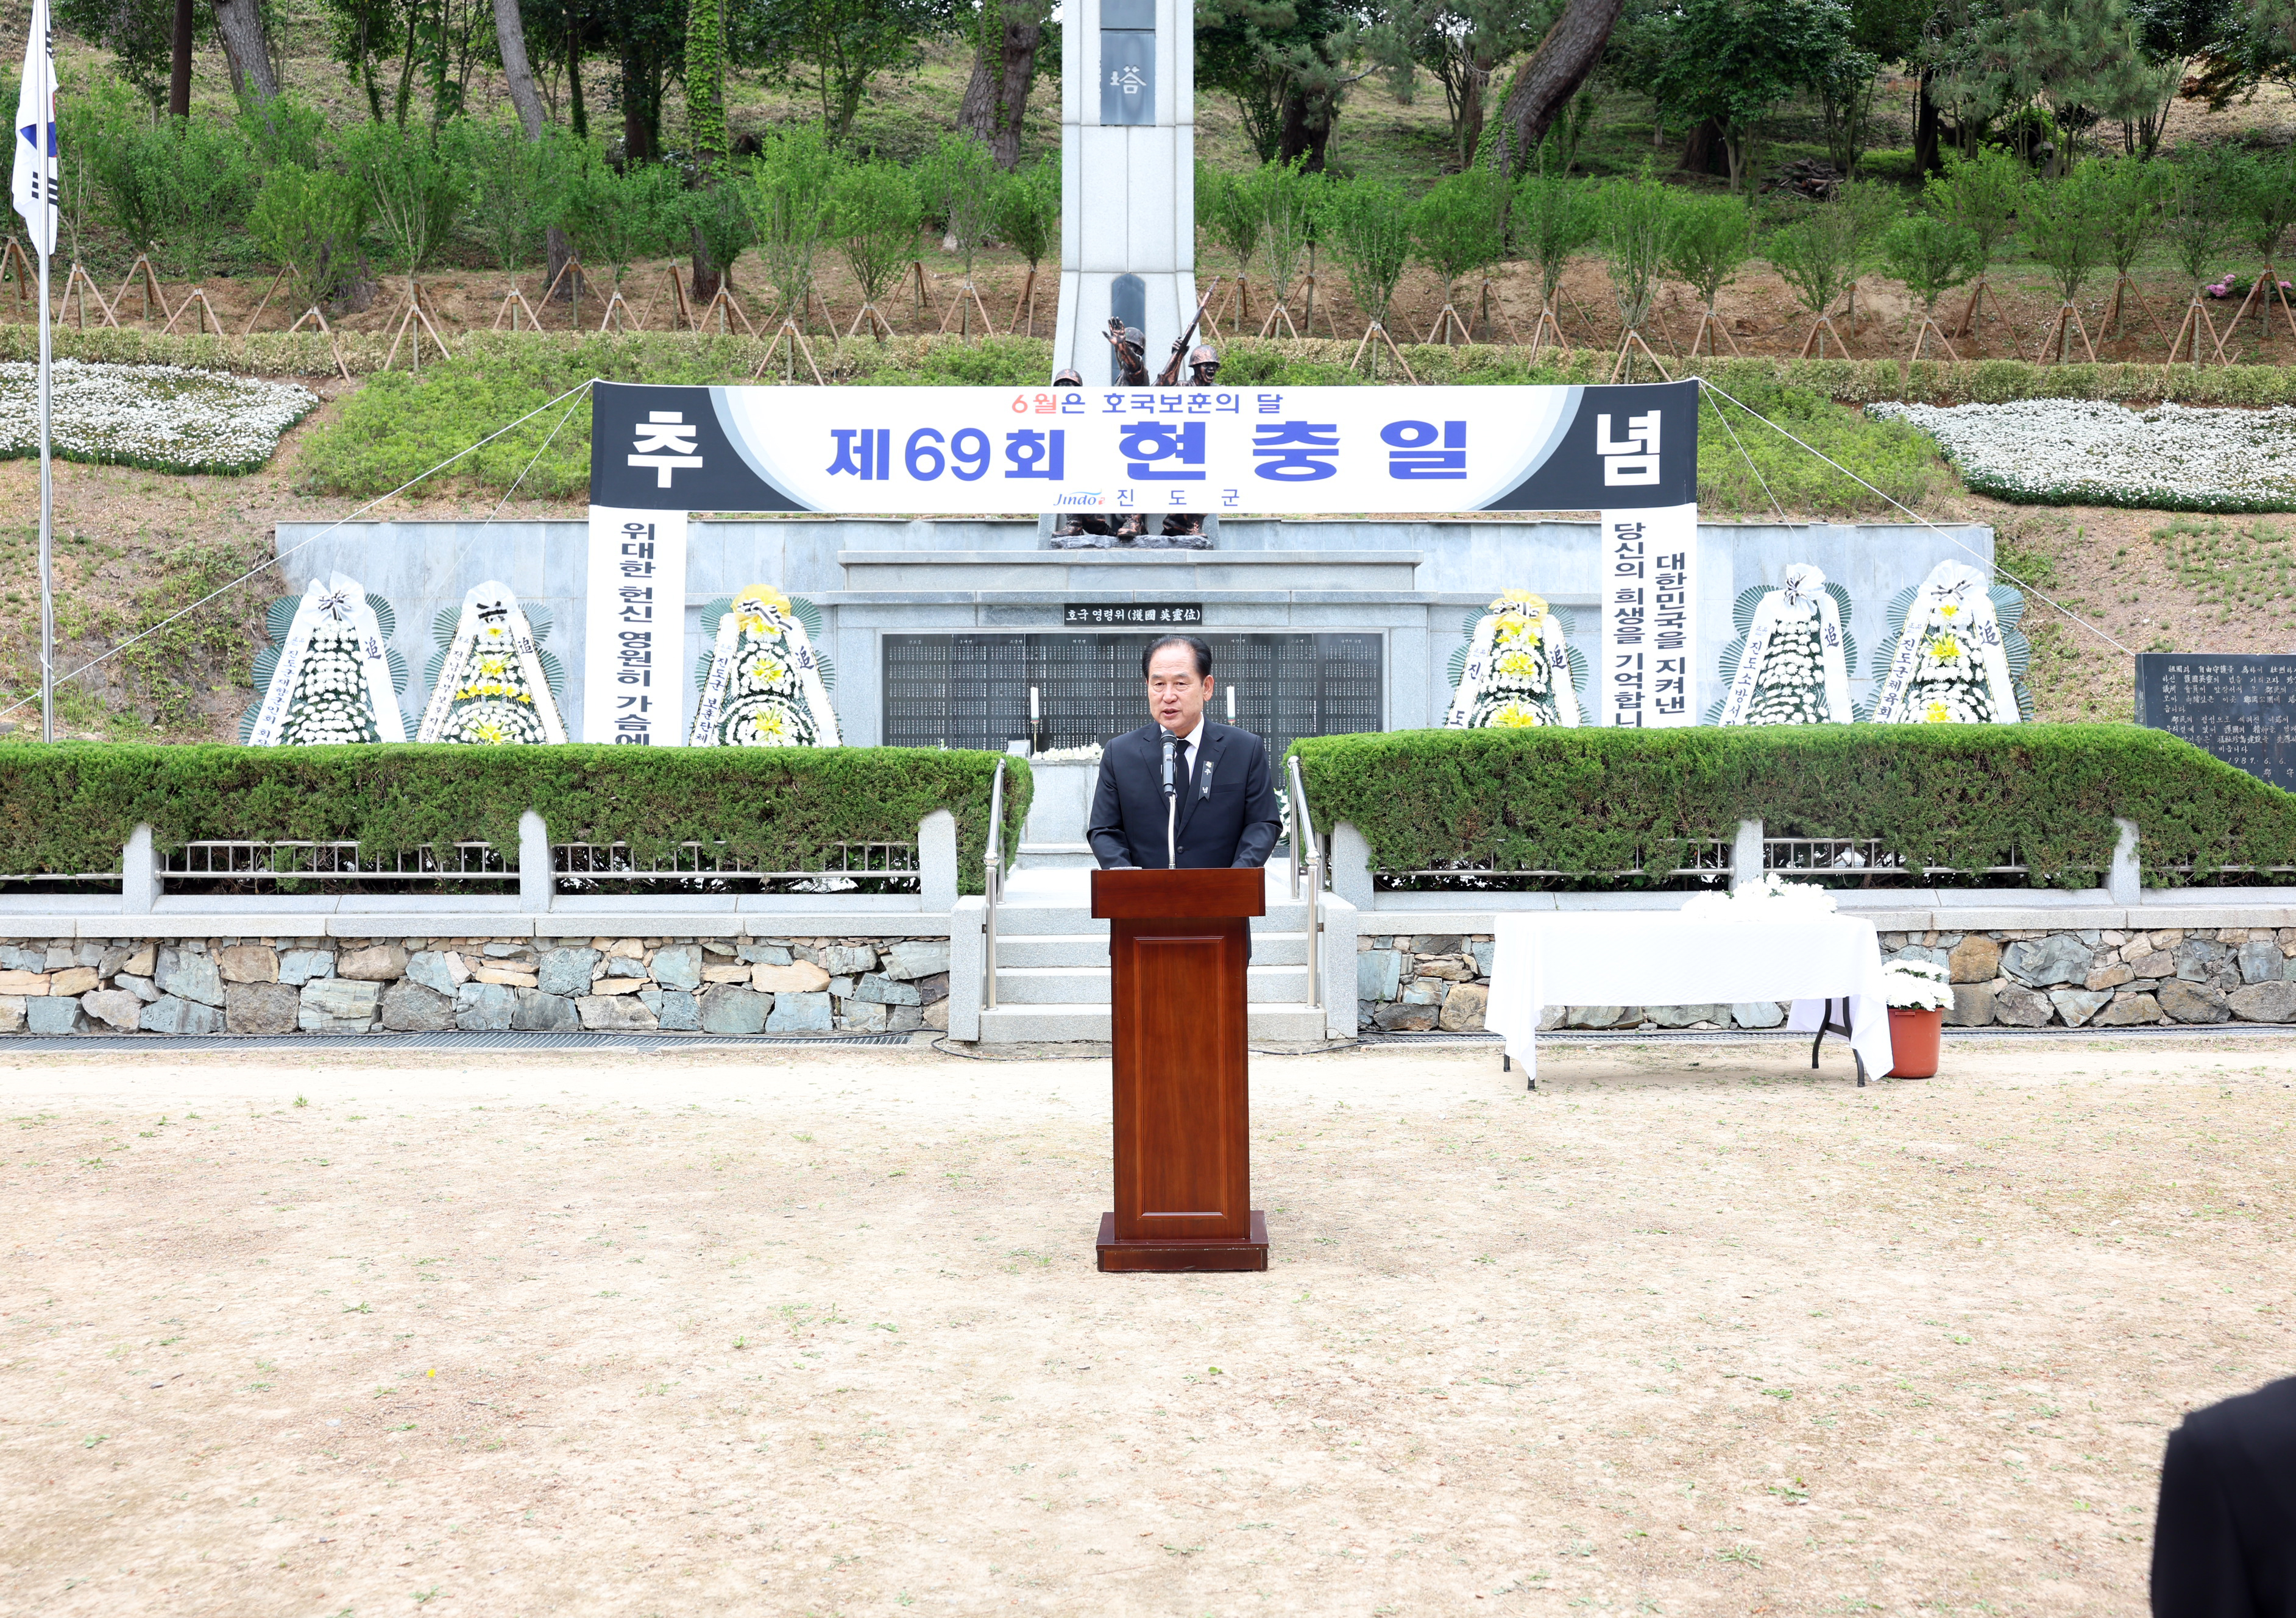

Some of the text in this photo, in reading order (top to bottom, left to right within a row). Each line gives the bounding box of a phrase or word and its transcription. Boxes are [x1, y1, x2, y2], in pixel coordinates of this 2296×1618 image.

[1110, 65, 1147, 94] 塔
[1012, 393, 1283, 414] 6월은 호국보훈의 달
[628, 411, 703, 488] 추
[826, 428, 1065, 481] 제69회
[1596, 410, 1661, 486] 념
[1053, 493, 1097, 506] Jindo
[619, 523, 656, 578] 위대한
[1614, 522, 1646, 579] 당신의
[617, 586, 653, 623] 헌신
[1066, 609, 1089, 621] 호국
[1614, 587, 1646, 645] 희생을
[365, 637, 382, 660] 追
[518, 637, 533, 655] 追
[1654, 552, 1687, 715] 대한민국을 지켜낸
[1824, 623, 1840, 648] 追
[1978, 620, 2000, 646] 追
[617, 631, 651, 687] 영원히
[795, 645, 815, 669] 追
[1550, 644, 1567, 669] 追
[1876, 638, 1915, 724] 진도군체육회
